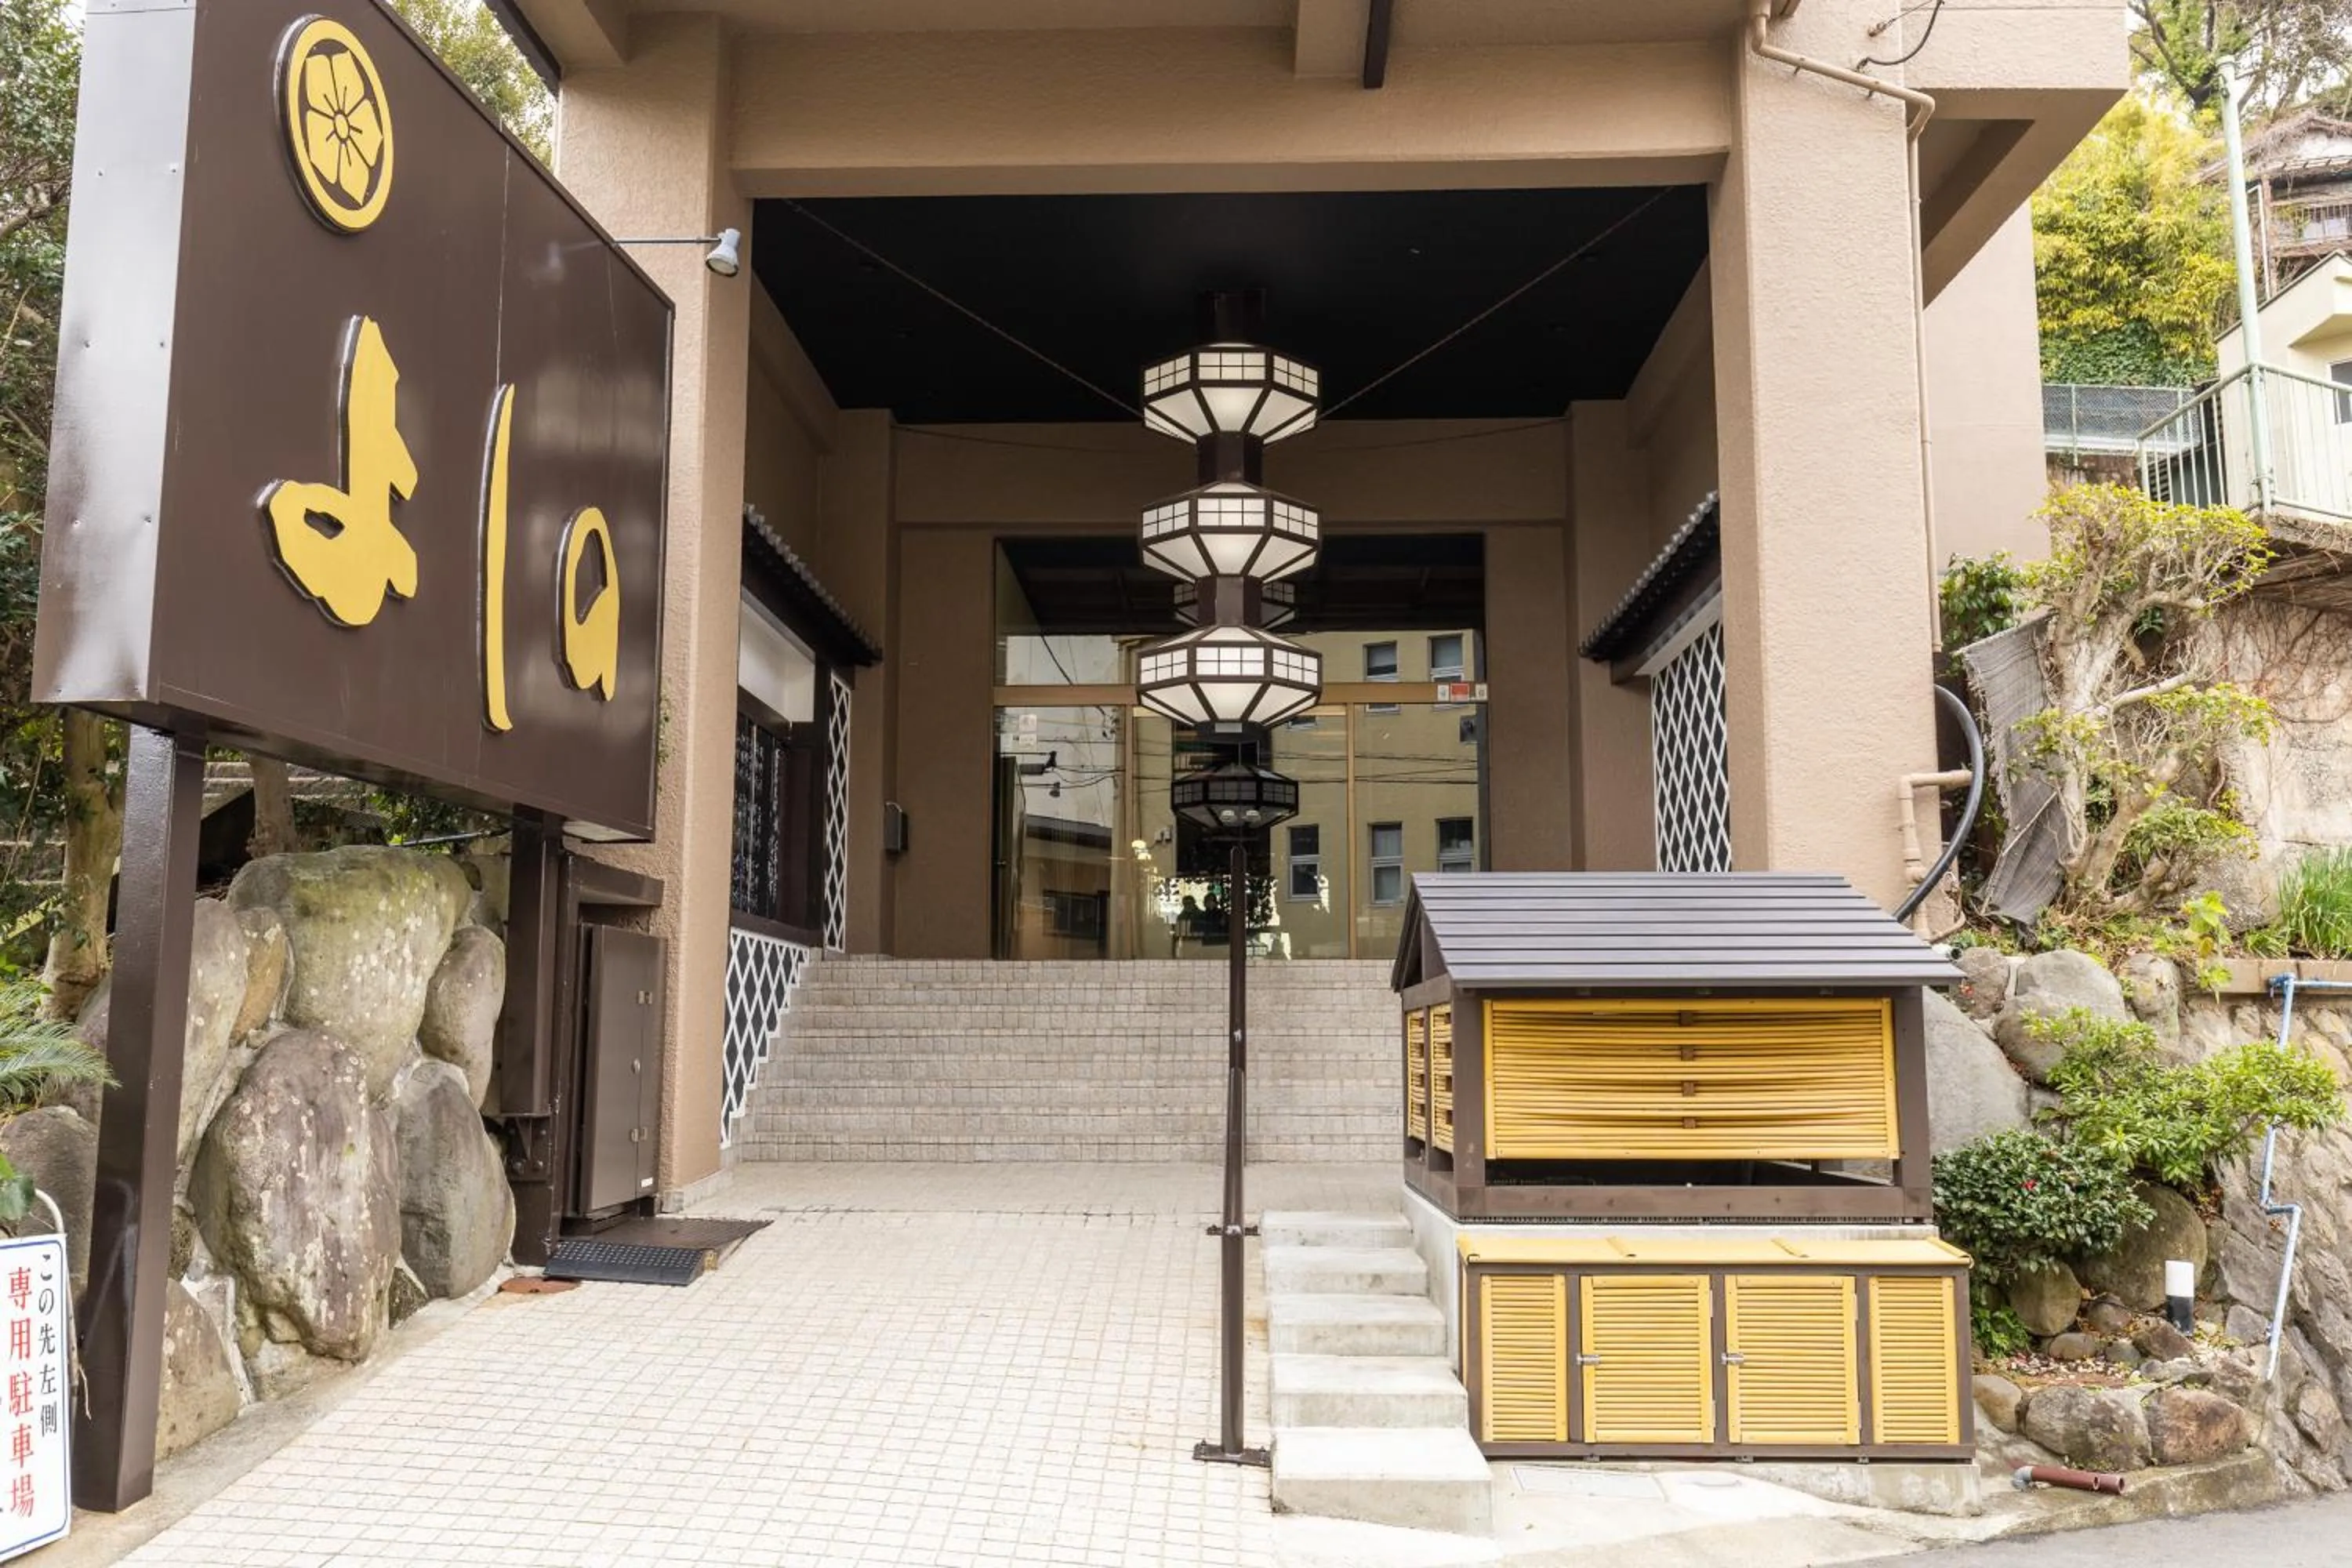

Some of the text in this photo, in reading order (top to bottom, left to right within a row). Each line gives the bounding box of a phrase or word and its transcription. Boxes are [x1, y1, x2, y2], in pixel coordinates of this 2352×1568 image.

[8, 1266, 34, 1519] 専用駐車場
[38, 1254, 57, 1437] この先左側
